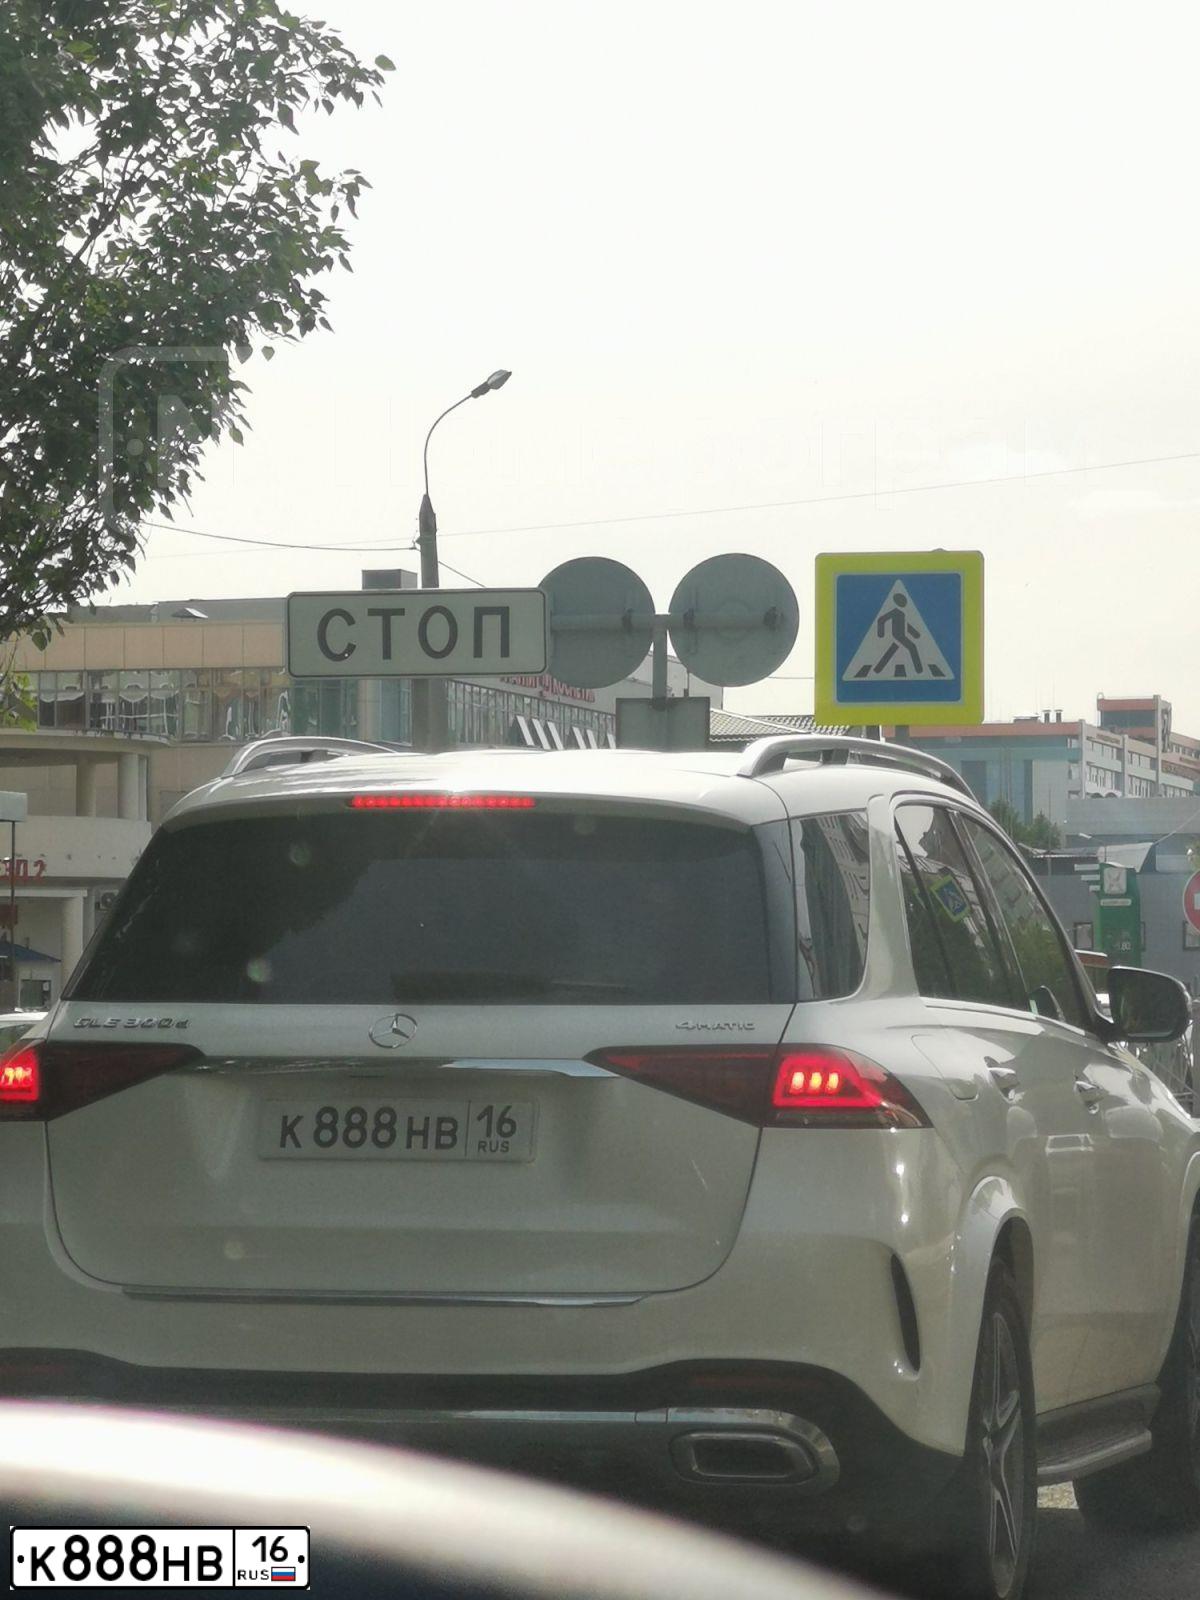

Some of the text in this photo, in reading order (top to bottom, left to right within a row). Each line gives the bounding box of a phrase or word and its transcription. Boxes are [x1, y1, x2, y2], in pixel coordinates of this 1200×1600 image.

[317, 605, 510, 662] СТОП
[73, 1018, 121, 1029] GLE
[675, 1021, 755, 1031] 4MATIC
[476, 1104, 518, 1139] 16
[477, 1140, 510, 1153] RUS
